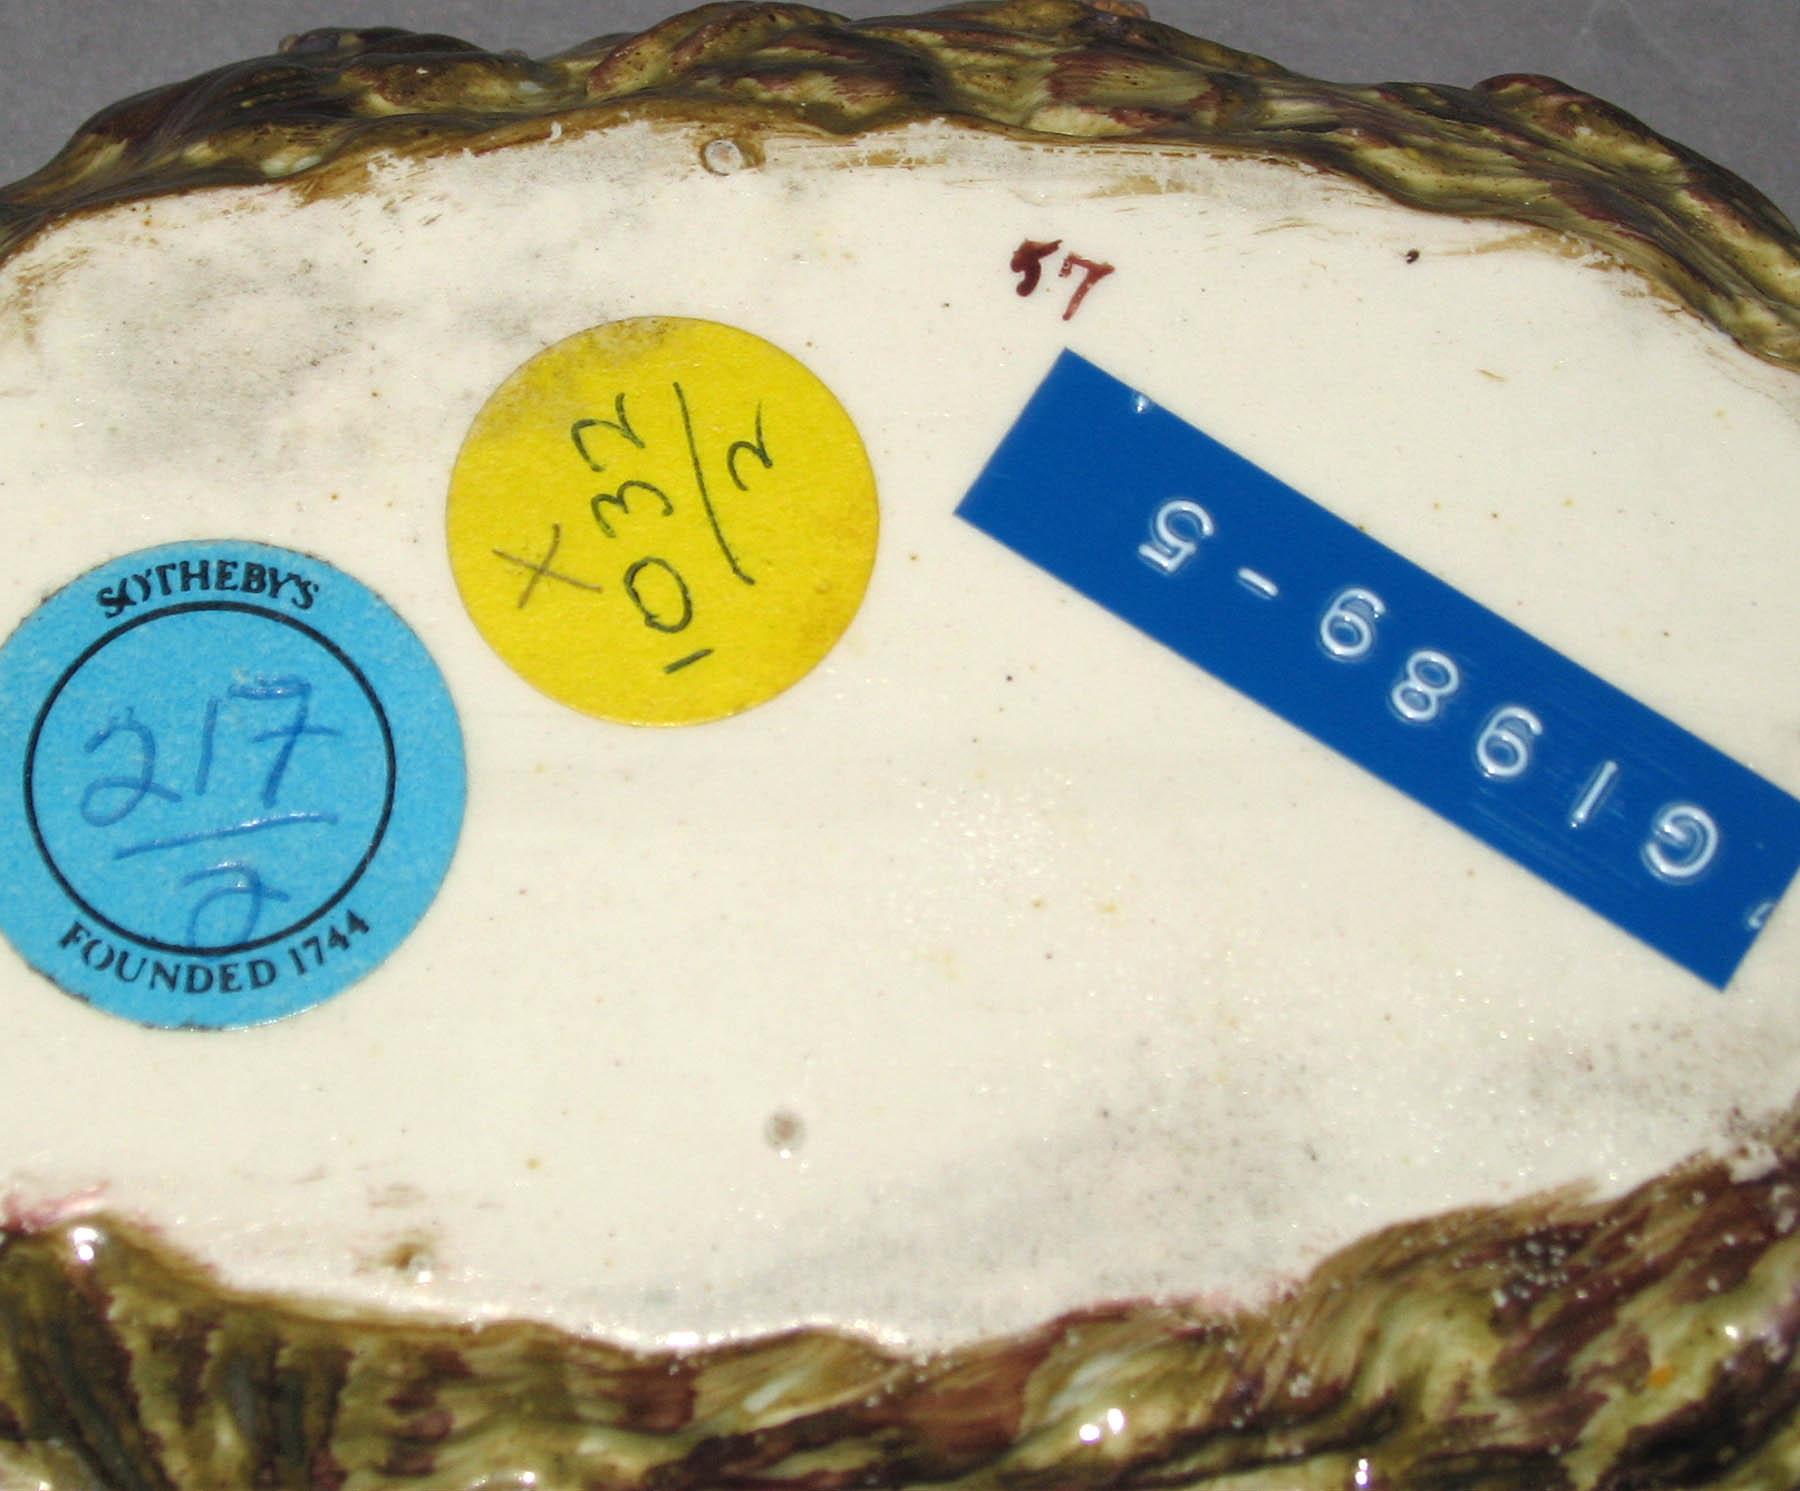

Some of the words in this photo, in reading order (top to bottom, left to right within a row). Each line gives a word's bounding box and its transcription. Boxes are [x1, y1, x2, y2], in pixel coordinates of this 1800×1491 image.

[727, 399, 773, 491] 2
[571, 393, 715, 674] 1032
[96, 559, 320, 619] SOTHEBY'S
[80, 674, 342, 827] 217
[58, 920, 277, 994] FOUNDED
[290, 908, 371, 976] 1744
